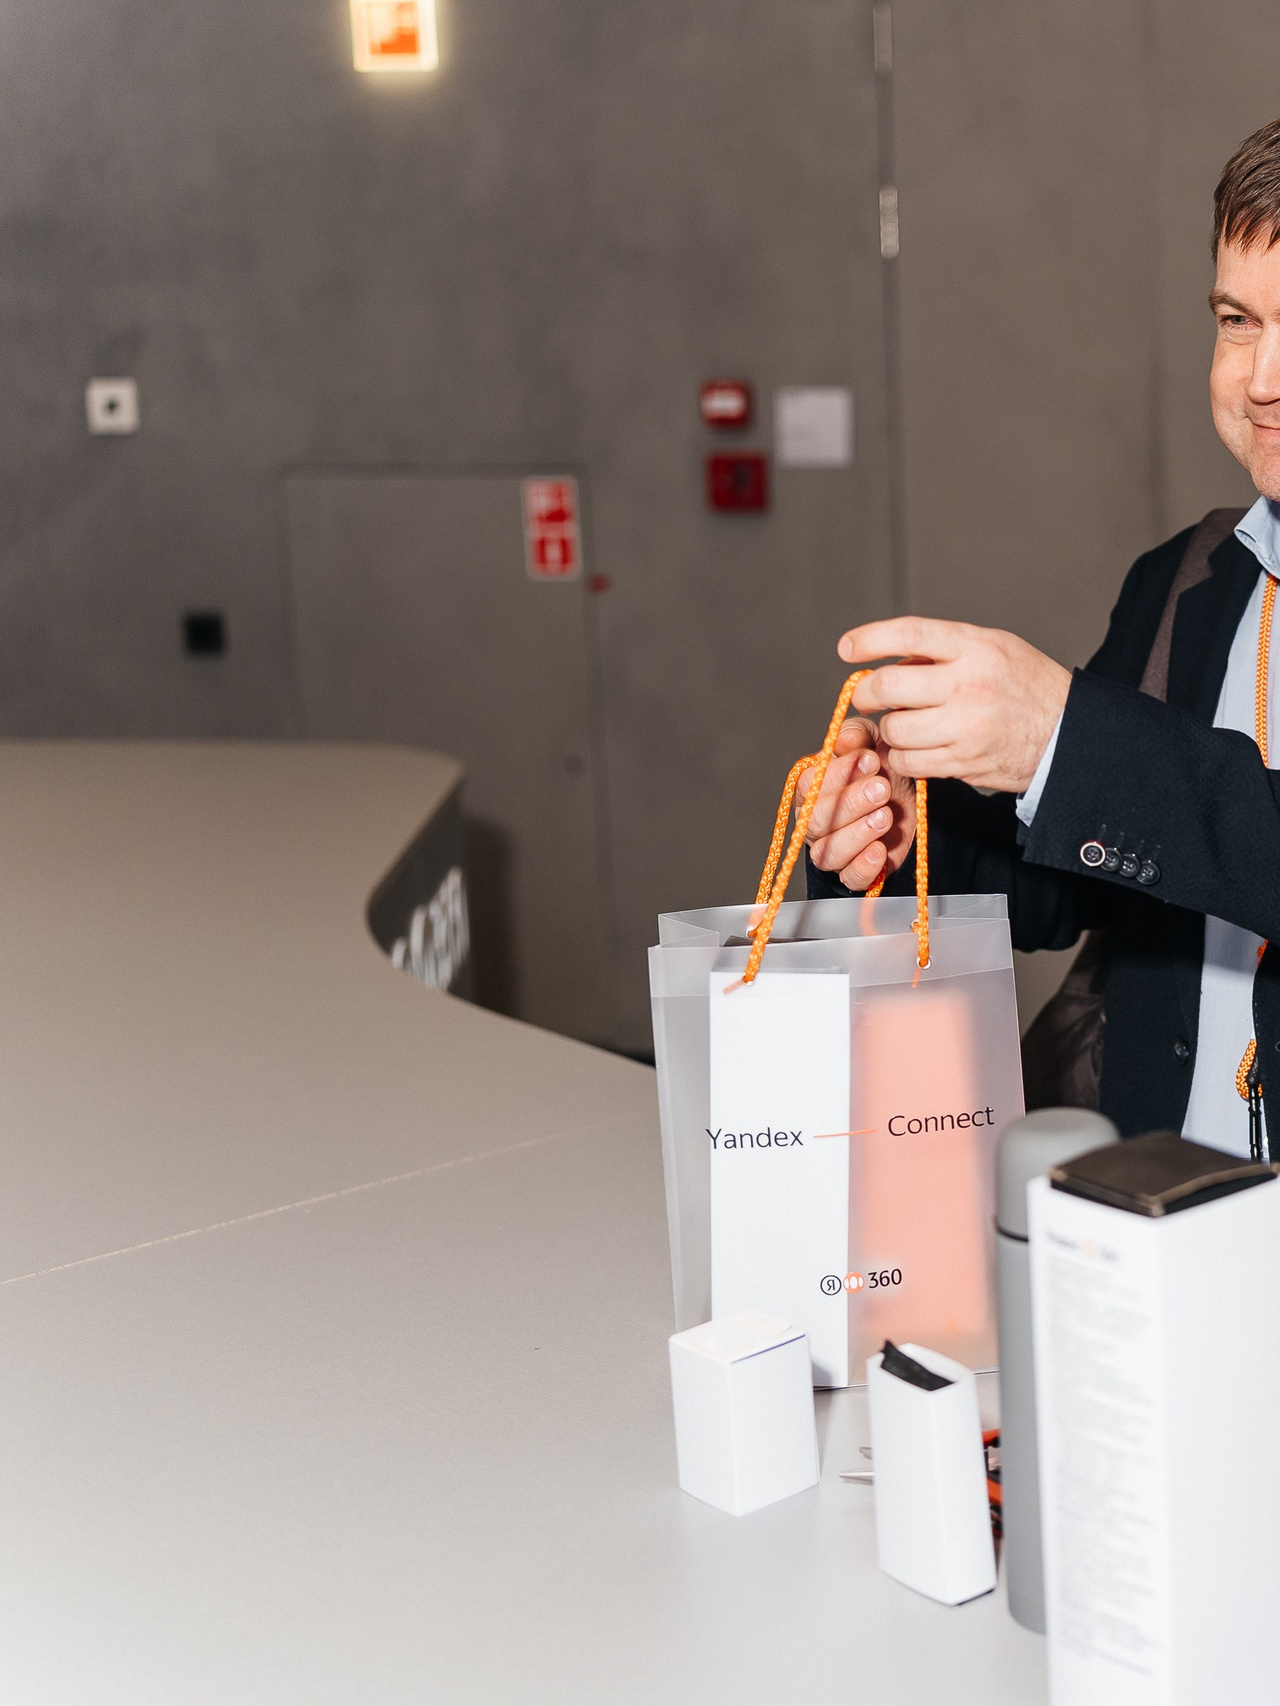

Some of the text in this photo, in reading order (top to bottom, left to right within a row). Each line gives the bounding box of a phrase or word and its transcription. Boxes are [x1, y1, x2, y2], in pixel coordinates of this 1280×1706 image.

[705, 1106, 995, 1150] Yandex Connect
[867, 1268, 903, 1289] 360
